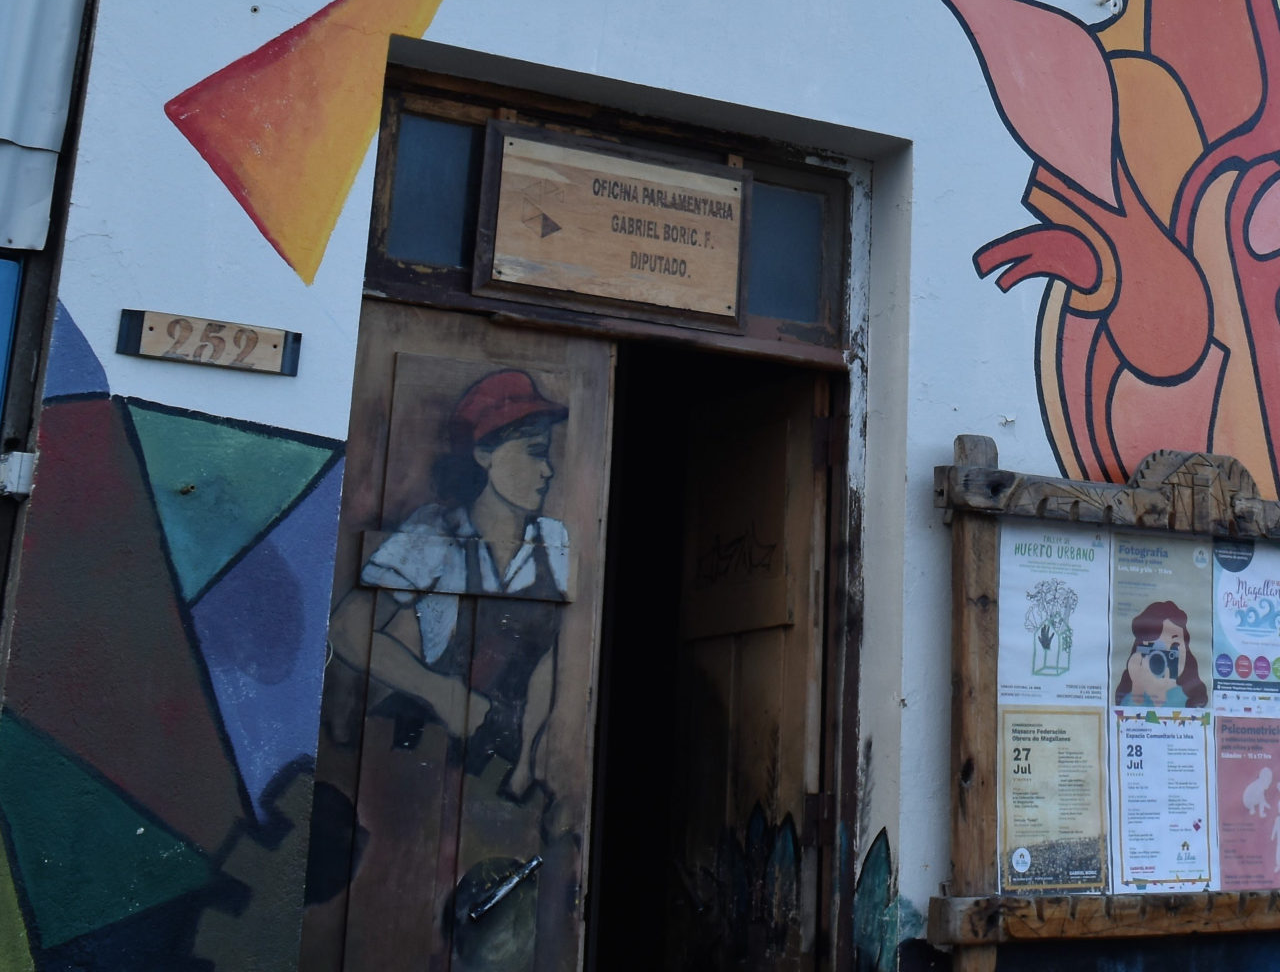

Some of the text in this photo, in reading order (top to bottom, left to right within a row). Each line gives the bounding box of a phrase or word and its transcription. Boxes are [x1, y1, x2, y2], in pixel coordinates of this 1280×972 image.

[592, 178, 734, 222] OFICINA PARLAMENTARIA
[611, 214, 660, 241] GABRIEL
[162, 318, 259, 369] 252
[1015, 543, 1095, 562] HUERTO URBANO
[1118, 545, 1168, 558] Fotografía
[1013, 747, 1031, 762] 27
[1127, 744, 1143, 758] 28
[1013, 764, 1032, 775] Jul
[1127, 760, 1144, 771] Jul
